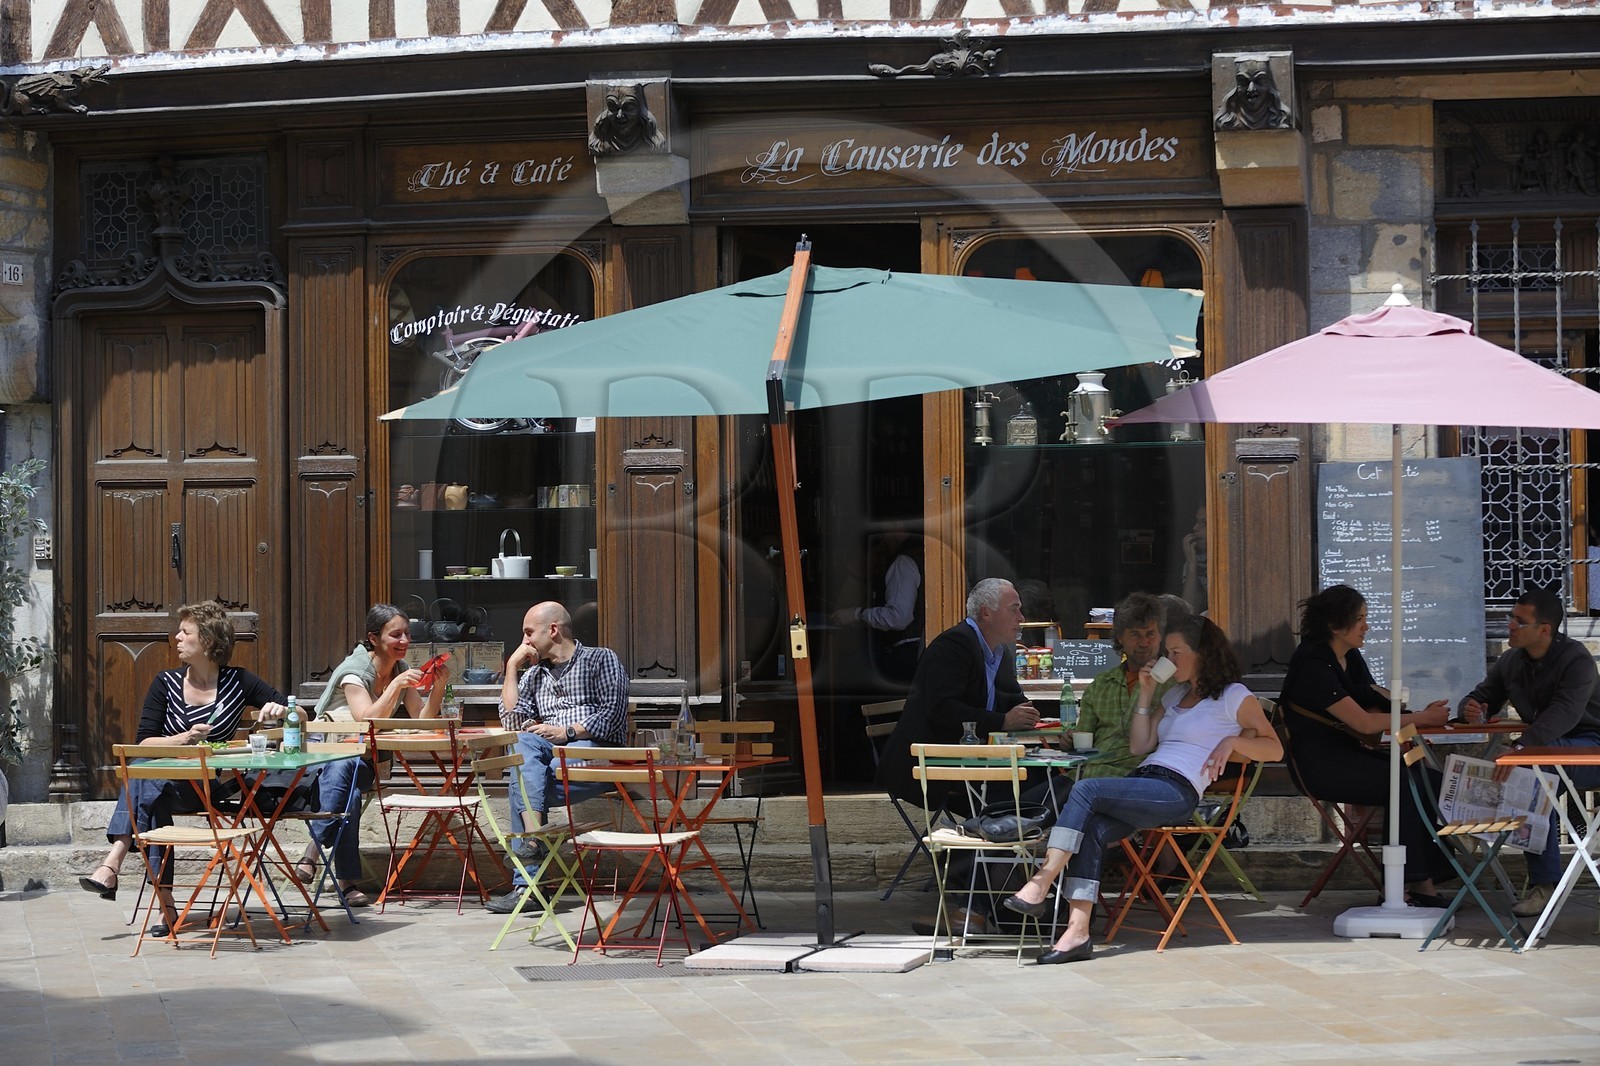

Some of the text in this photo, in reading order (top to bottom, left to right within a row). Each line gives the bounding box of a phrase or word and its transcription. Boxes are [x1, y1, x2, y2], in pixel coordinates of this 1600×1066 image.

[741, 127, 1179, 185] La Causerie des Mondes
[408, 156, 574, 192] Thé & Café
[9, 265, 19, 281] 16
[390, 305, 470, 345] Comptoir
[471, 304, 485, 320] &
[1357, 463, 1383, 480] Cet
[1443, 775, 1458, 804] Monde
